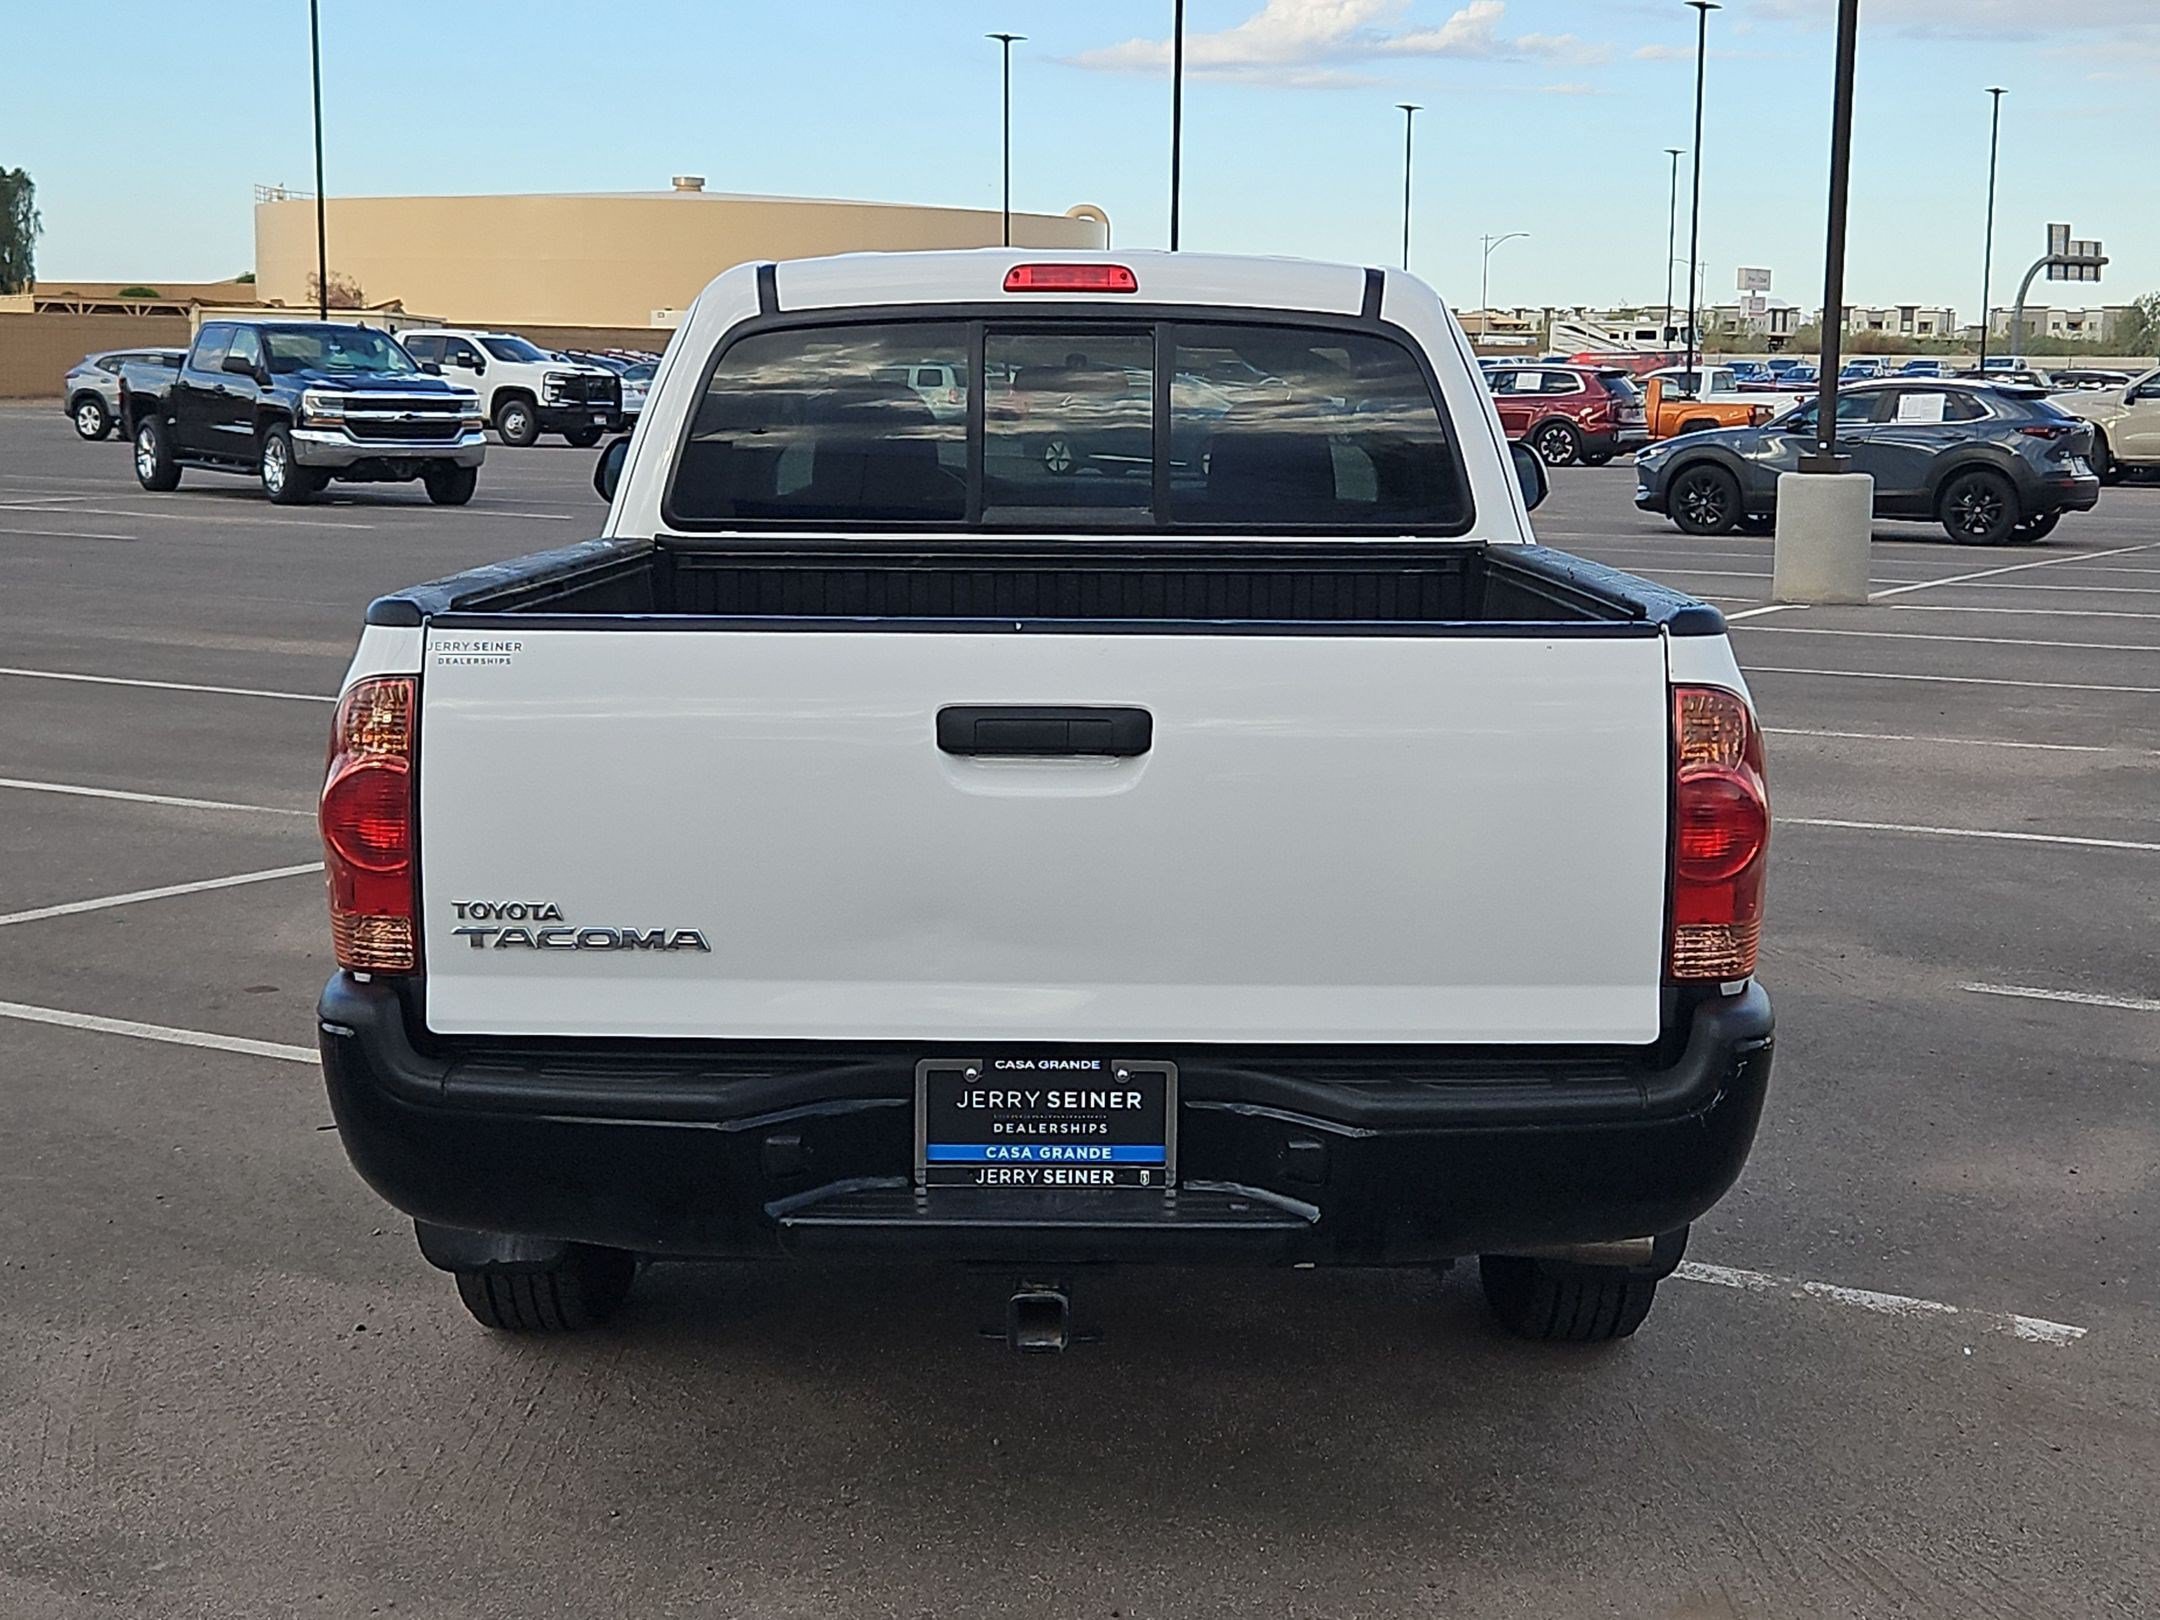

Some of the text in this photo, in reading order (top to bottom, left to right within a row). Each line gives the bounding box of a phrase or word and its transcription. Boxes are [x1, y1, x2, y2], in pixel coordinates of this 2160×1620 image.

[427, 641, 522, 652] JERRY SEINER
[438, 657, 512, 665] DEALERSHIPS
[450, 900, 564, 921] TOYOTA
[451, 926, 712, 953] TACOMA
[994, 1059, 1101, 1070] CASA GRANDE
[956, 1091, 1142, 1109] JERRY SEINER
[993, 1123, 1108, 1134] DEALERSHIPS
[985, 1146, 1113, 1159] CASA GRANDE
[975, 1169, 1115, 1184] JERRY SEINER
